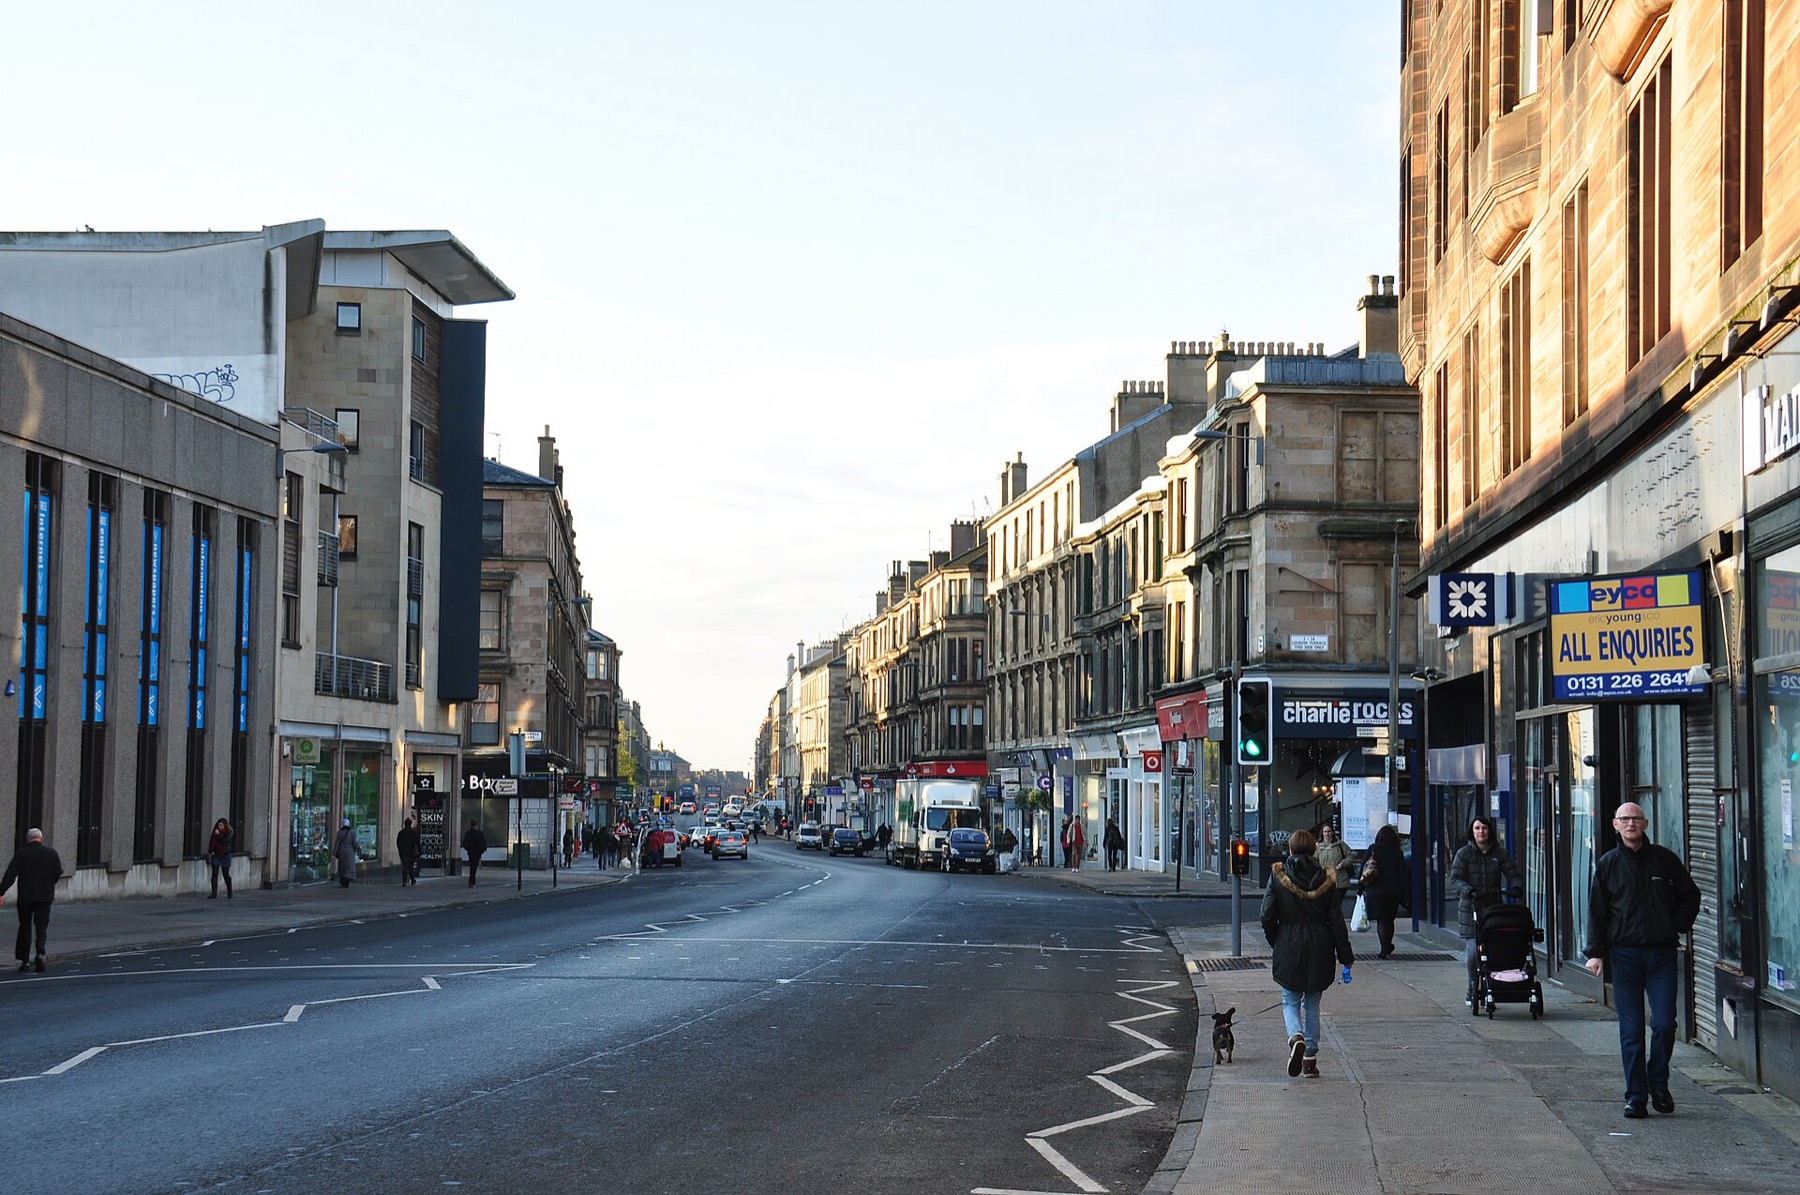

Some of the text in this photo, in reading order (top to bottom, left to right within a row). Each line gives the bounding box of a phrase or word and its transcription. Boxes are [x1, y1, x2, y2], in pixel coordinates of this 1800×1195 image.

[1591, 584, 1655, 605] eyco
[1560, 625, 1694, 666] ALL ENQUIRIES
[1567, 675, 1603, 691] 0131
[1611, 673, 1643, 689] 226
[1283, 701, 1413, 723] charlie rocs
[420, 813, 444, 822] SKIN
[420, 837, 443, 845] FOOD
